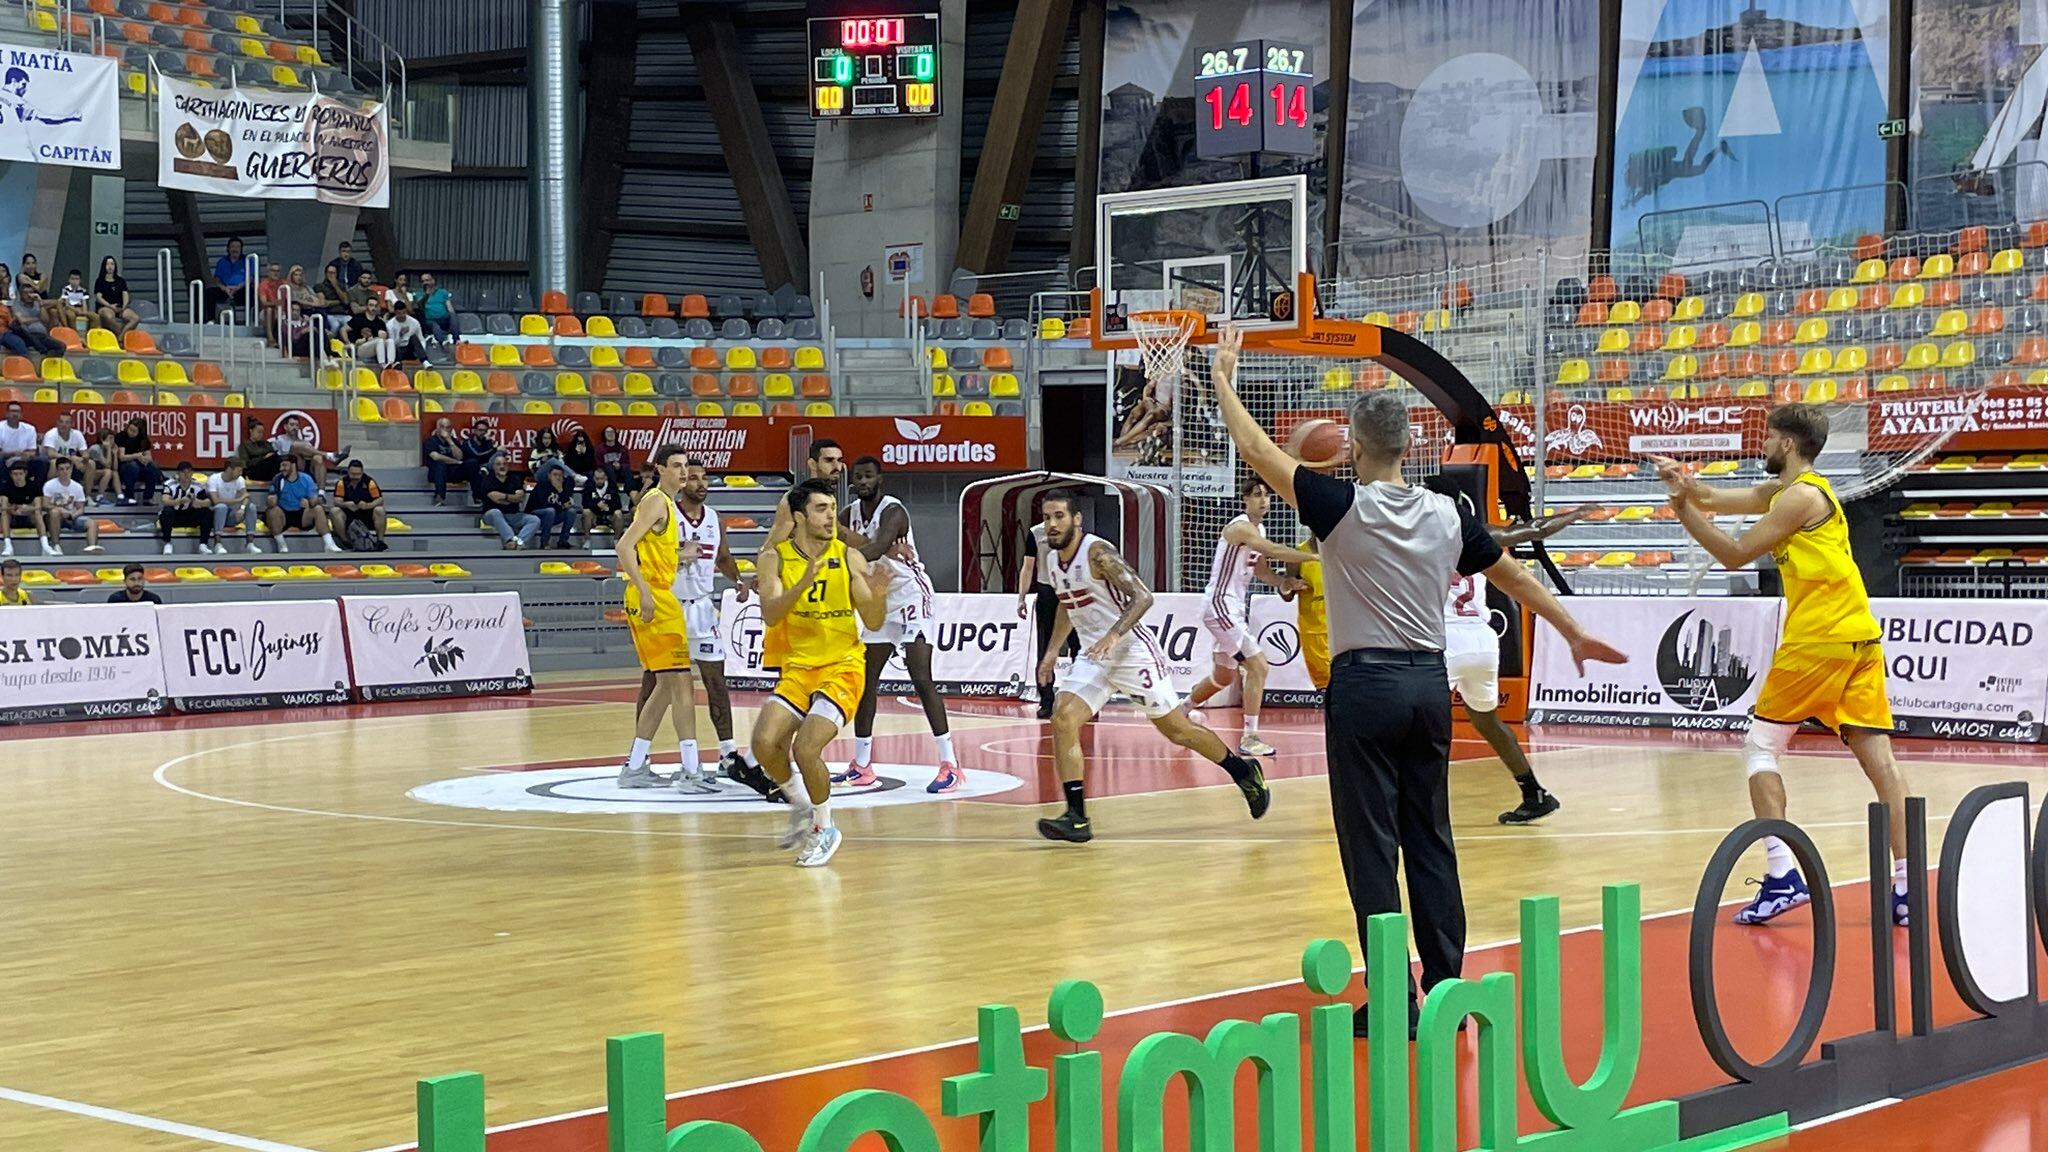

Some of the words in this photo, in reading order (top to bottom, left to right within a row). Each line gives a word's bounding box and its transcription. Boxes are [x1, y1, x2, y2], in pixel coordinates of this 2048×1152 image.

[836, 56, 850, 81] 0
[917, 53, 932, 79] 0
[1201, 47, 1249, 76] 26.7
[1267, 46, 1305, 73] 26.7
[1205, 82, 1254, 130] 14
[1270, 82, 1308, 128] 14
[242, 129, 257, 141] EN
[260, 130, 272, 142] EL
[40, 144, 112, 163] CAPITÁN
[882, 440, 996, 466] agriverdes
[1126, 469, 1168, 480] Nuestra
[362, 605, 419, 644] Cafés
[427, 602, 508, 632] Bernal
[900, 604, 917, 624] 12
[37, 627, 151, 662] TOMÁS
[937, 622, 1018, 652] UPCT
[184, 628, 241, 677] FCC
[250, 619, 324, 682] Business
[0, 668, 37, 690] rupo
[41, 667, 82, 684] desde
[87, 666, 116, 682] 1936
[465, 681, 504, 692] VAMOS!
[1138, 668, 1152, 689] 3
[390, 686, 437, 696] CARTAGENA
[892, 684, 917, 694] CARTA
[960, 684, 998, 695] VAMOS!
[1283, 693, 1325, 705] CARTAG
[1536, 683, 1661, 706] Inmobiliaria
[83, 702, 133, 716] VAMOS!
[205, 698, 253, 709] CARTAGENA
[282, 693, 324, 706] VAMOS!
[1568, 714, 1631, 725] CARTAGENA
[1671, 716, 1727, 730] VAMOS!
[1931, 720, 1994, 738] VAMOS!
